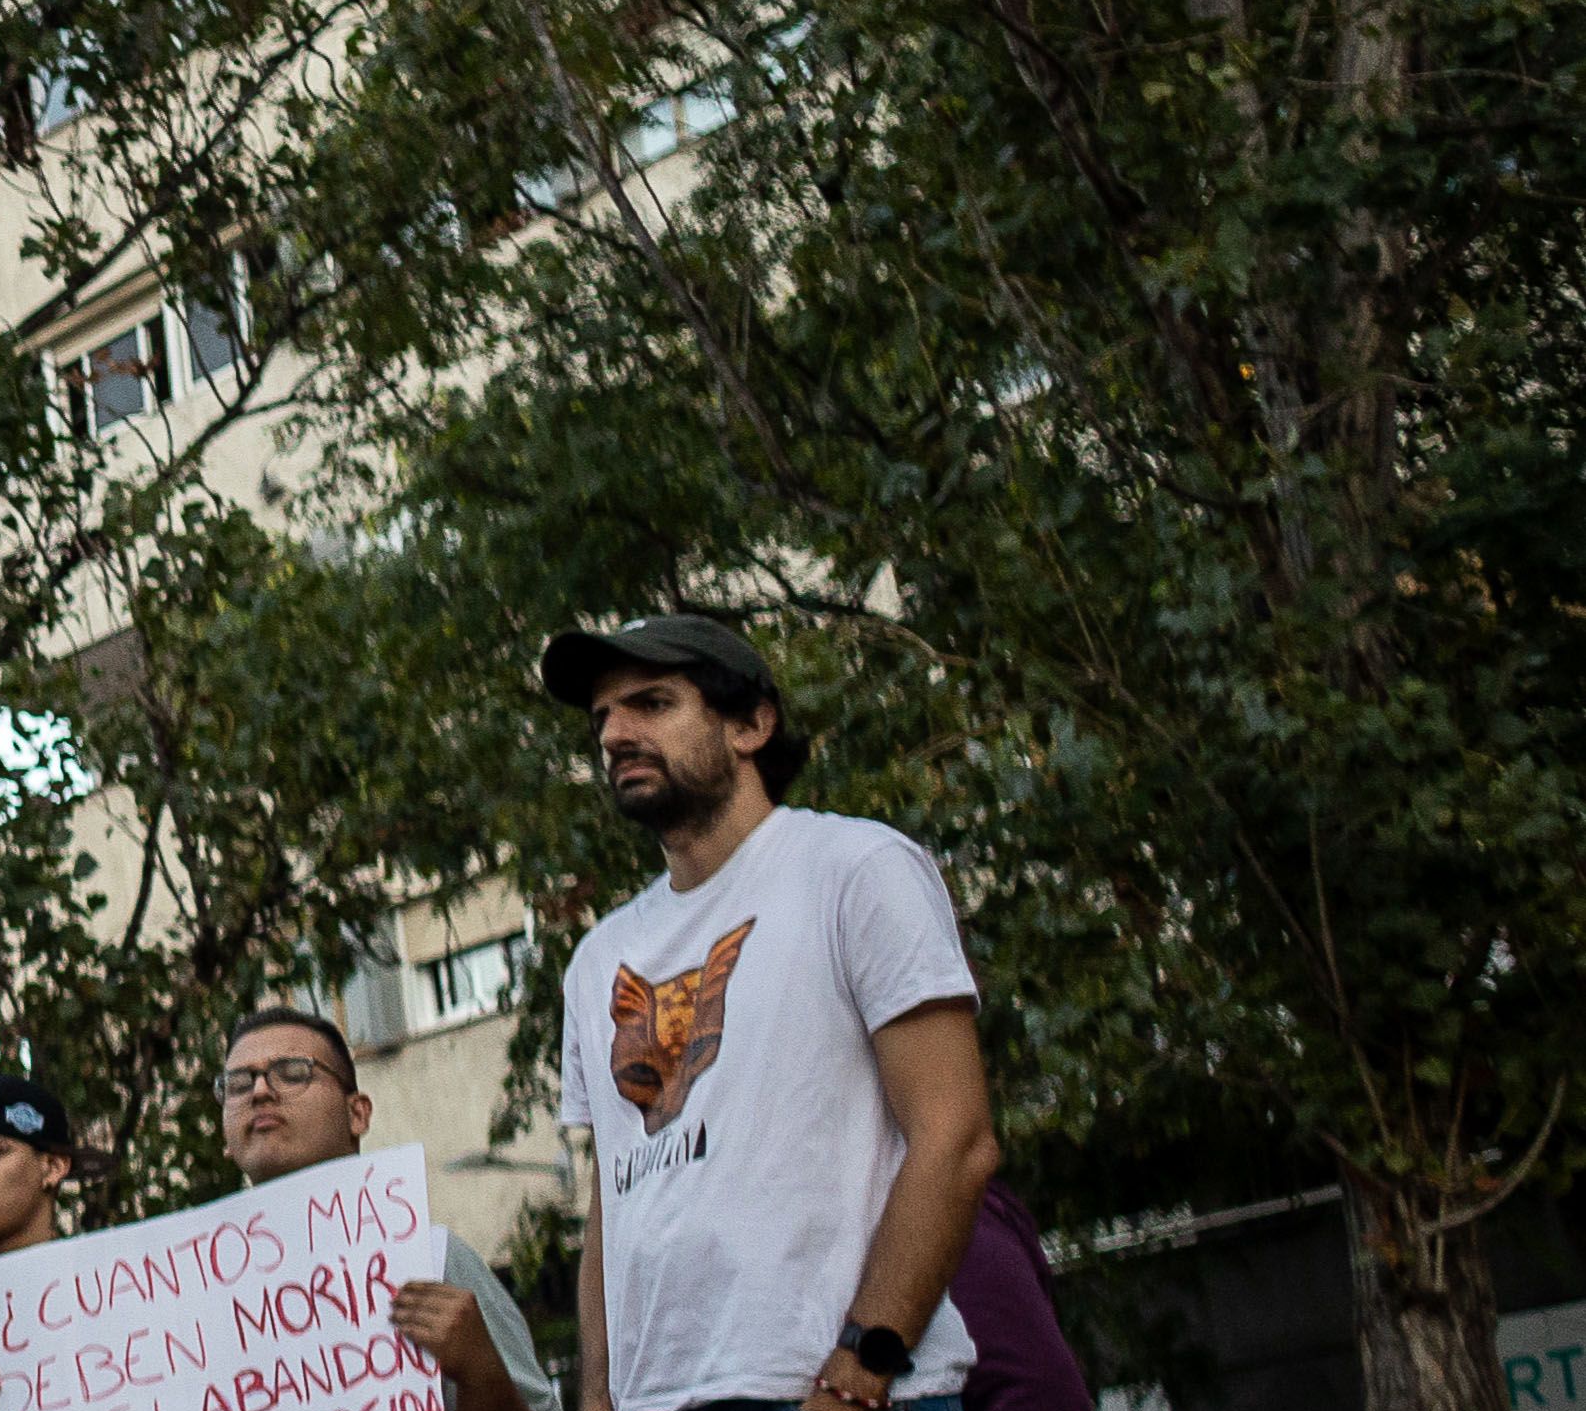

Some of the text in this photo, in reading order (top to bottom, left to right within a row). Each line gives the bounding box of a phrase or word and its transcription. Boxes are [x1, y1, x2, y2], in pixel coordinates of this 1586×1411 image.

[1, 1163, 418, 1354] ¿CUANTOS MÁS
[232, 1249, 400, 1354] MORIR
